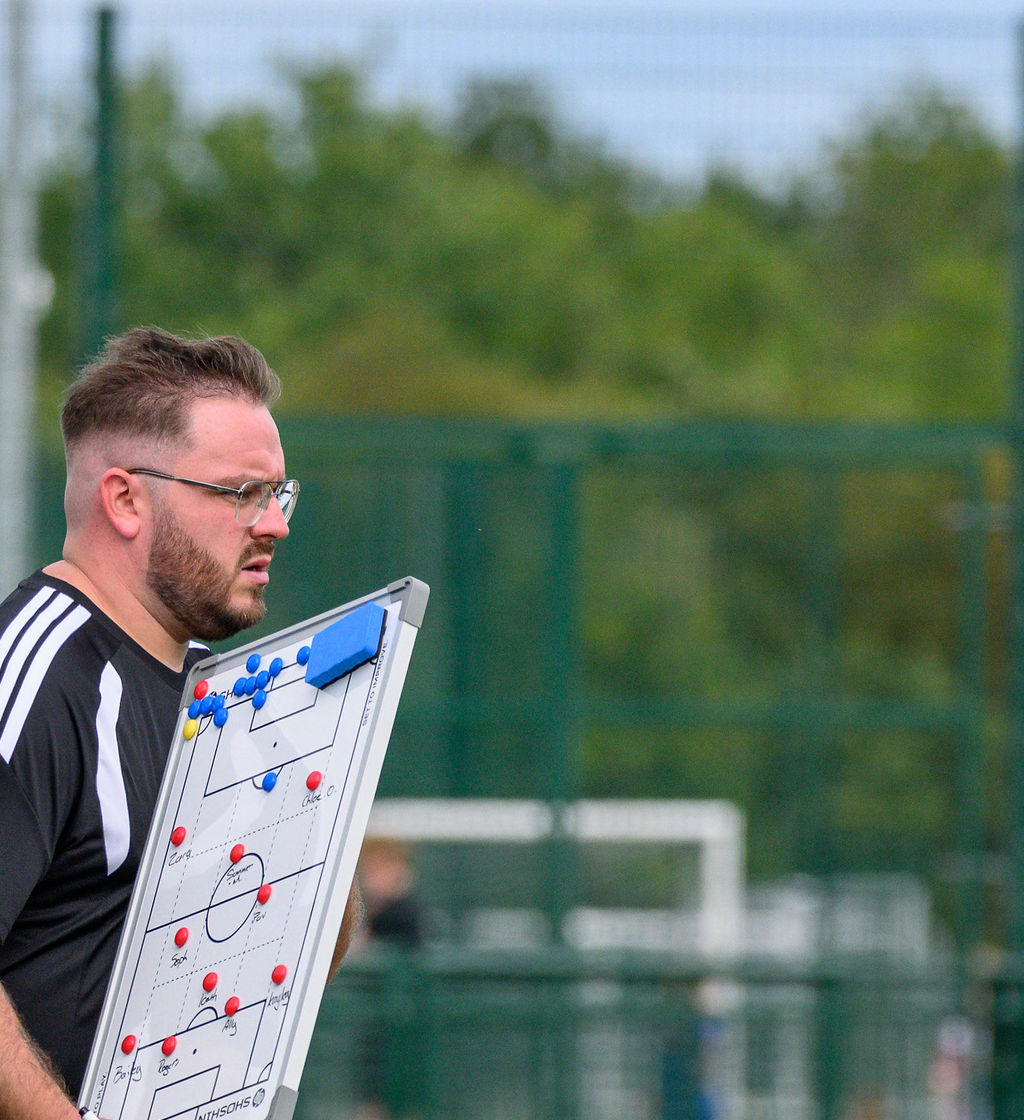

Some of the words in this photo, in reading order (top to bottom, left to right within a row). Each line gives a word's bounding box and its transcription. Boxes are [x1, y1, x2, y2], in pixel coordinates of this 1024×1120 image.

[362, 708, 371, 727] SET
[368, 691, 376, 705] TO
[373, 643, 388, 689] IMPROVE
[96, 1074, 107, 1100] PLAY
